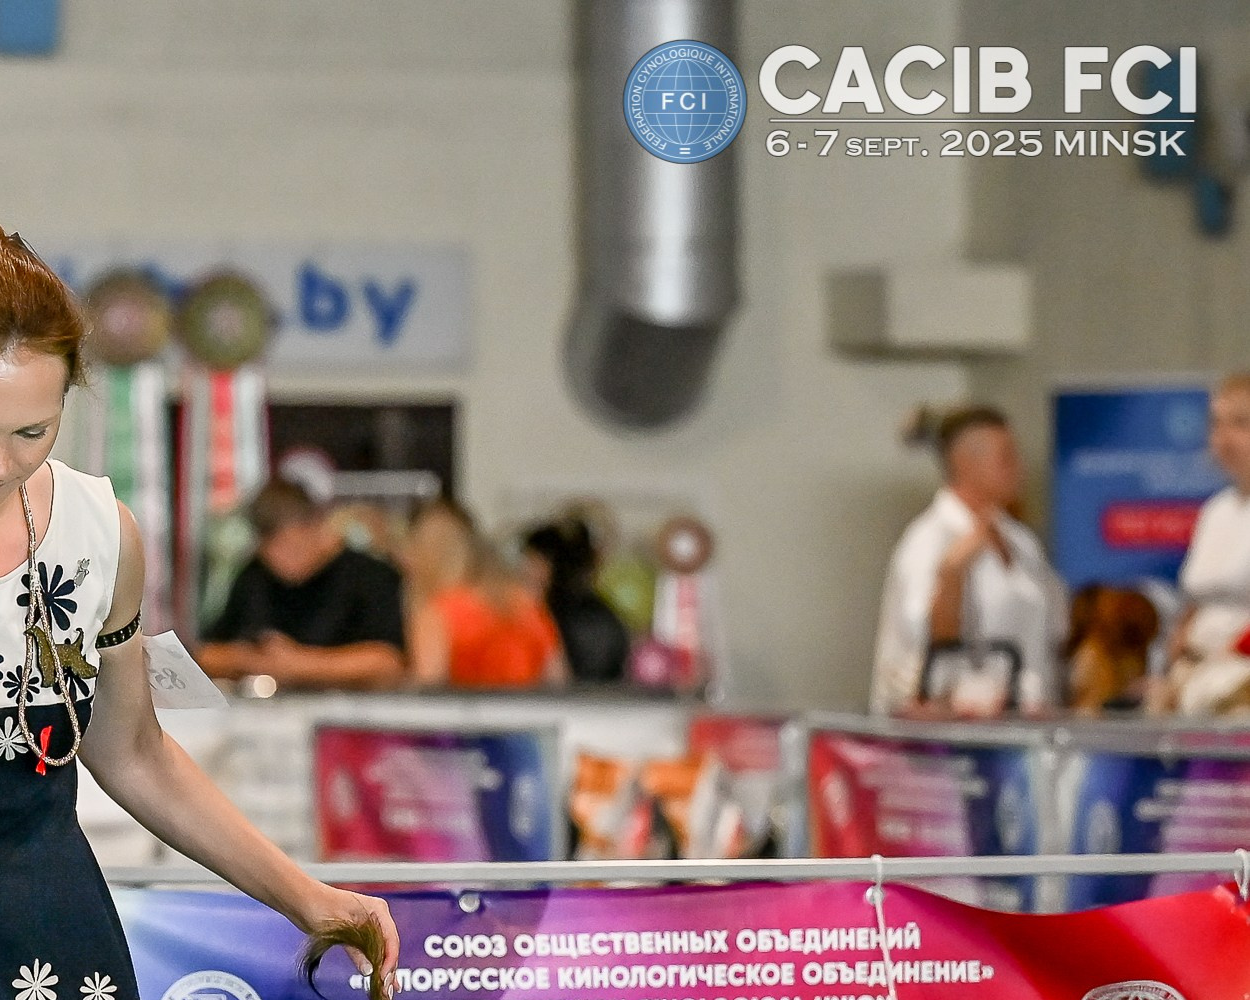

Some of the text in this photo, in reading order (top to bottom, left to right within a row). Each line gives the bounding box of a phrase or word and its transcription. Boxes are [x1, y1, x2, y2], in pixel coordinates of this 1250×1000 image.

[423, 921, 922, 960] СОЮЗ ОБЩЕСТВЕННЫХ ОБЪЕДИНЕНИЙ
[557, 962, 796, 989] КИНОЛОГИЧЕСКОЕ
[802, 959, 996, 988] ОБЪЕДИНЕНИЕ»
